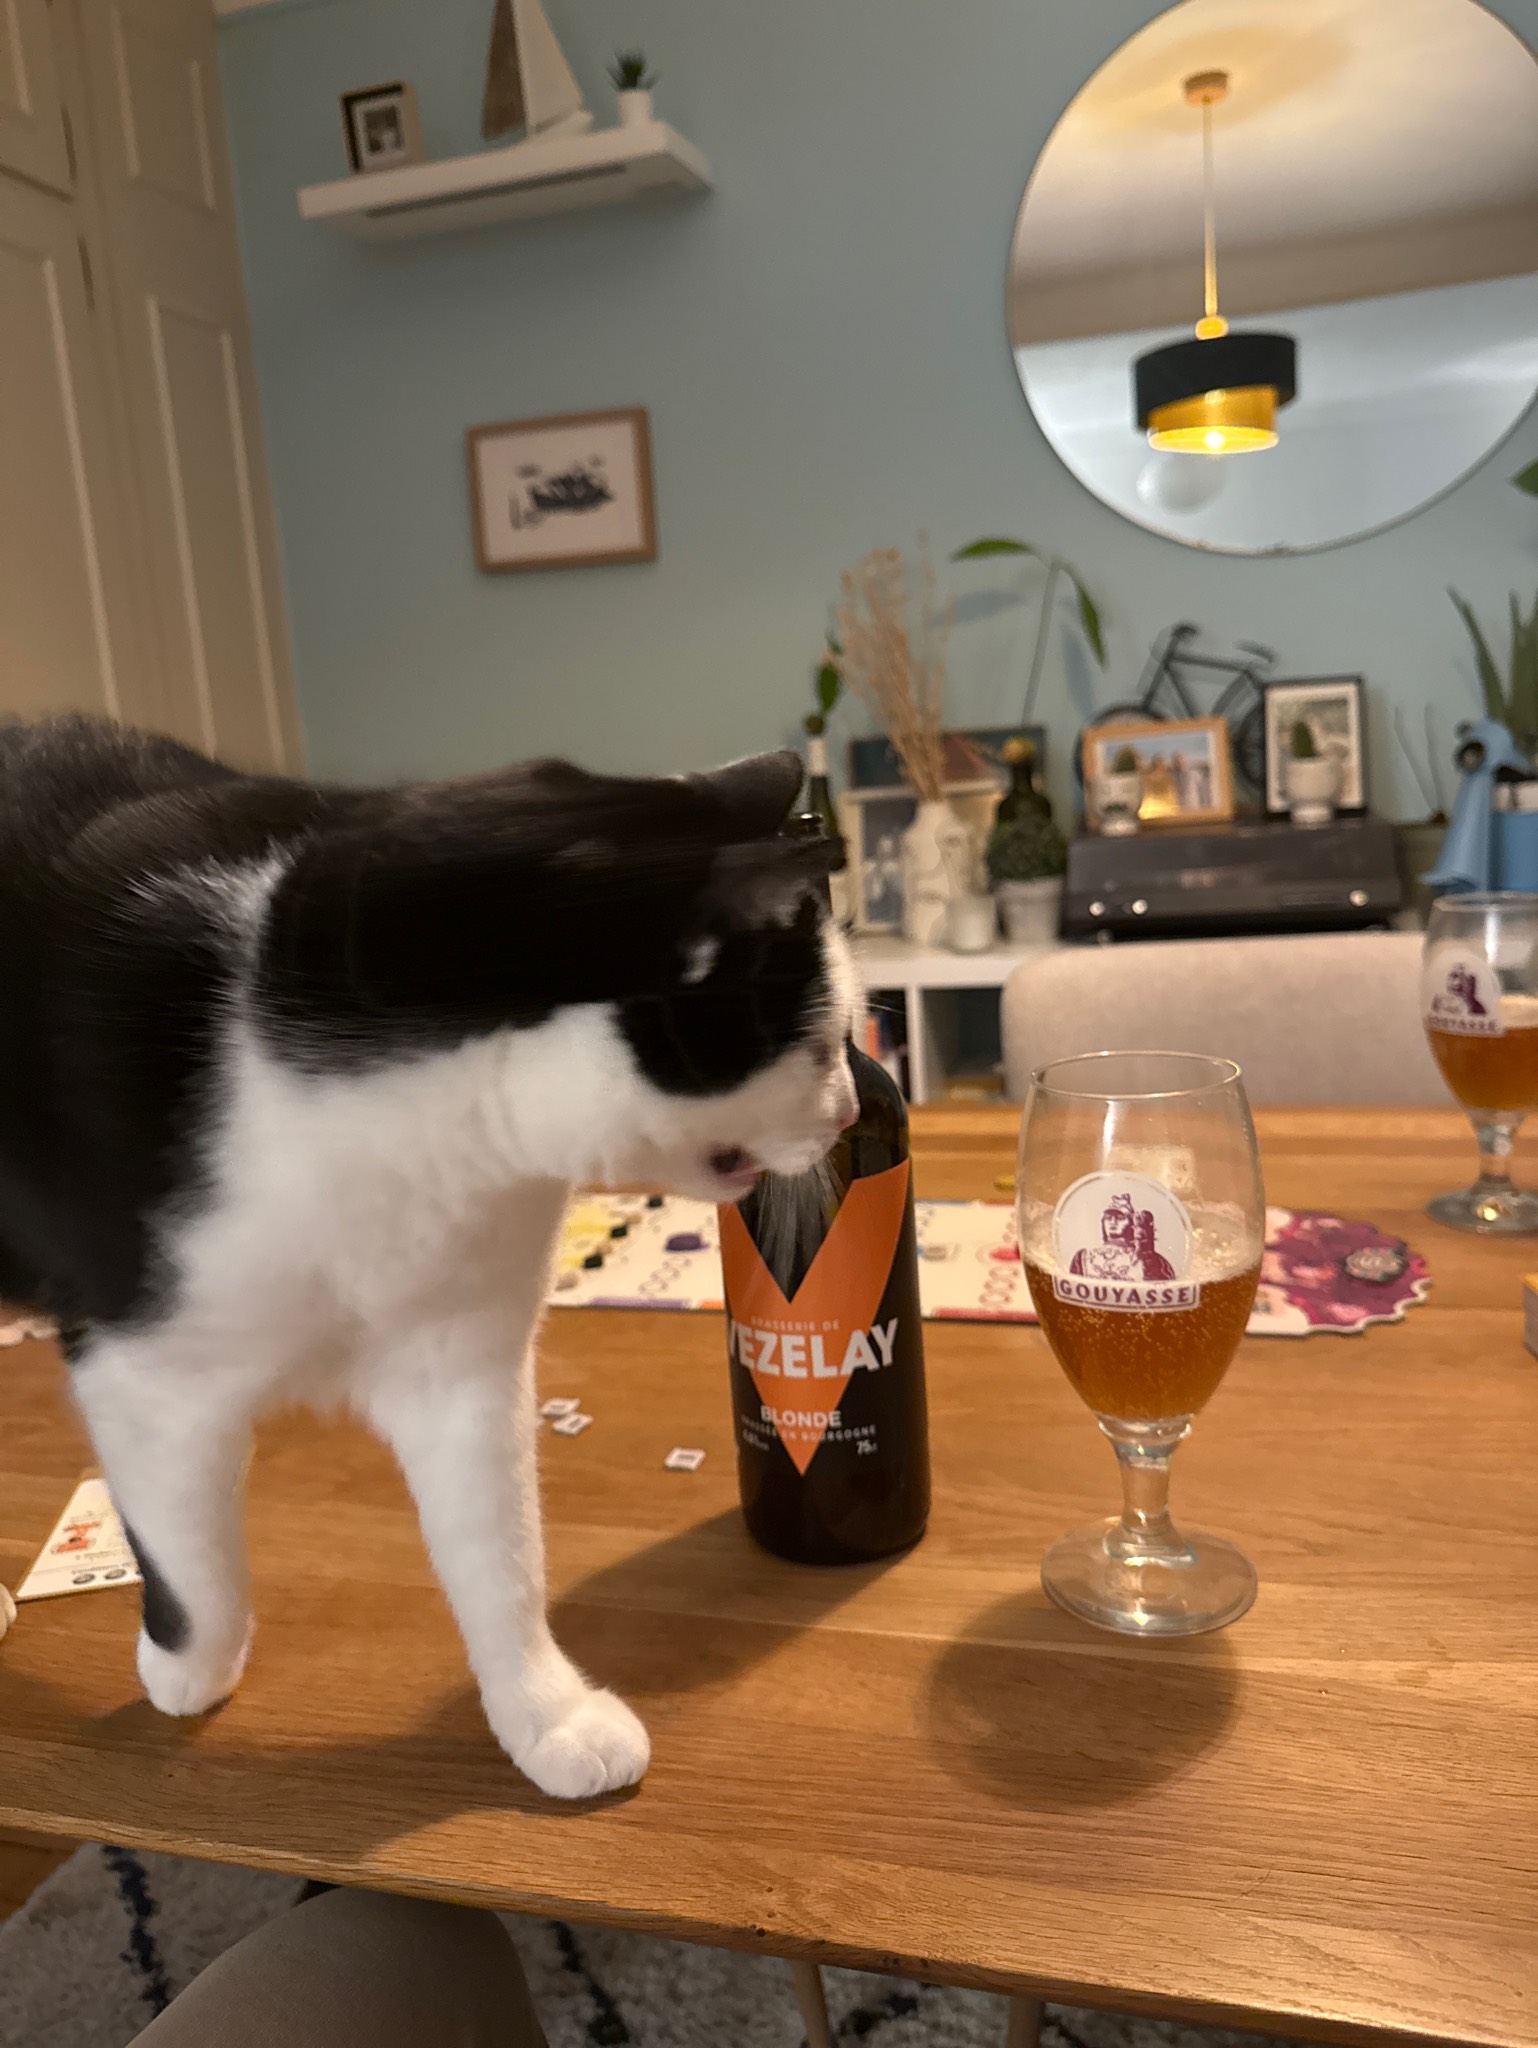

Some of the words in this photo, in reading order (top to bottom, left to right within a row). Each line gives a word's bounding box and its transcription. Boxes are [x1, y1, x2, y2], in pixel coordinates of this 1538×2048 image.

[1059, 1279, 1190, 1304] GOUYASSE
[822, 1319, 840, 1331] DE
[760, 1404, 842, 1428] BLONDE
